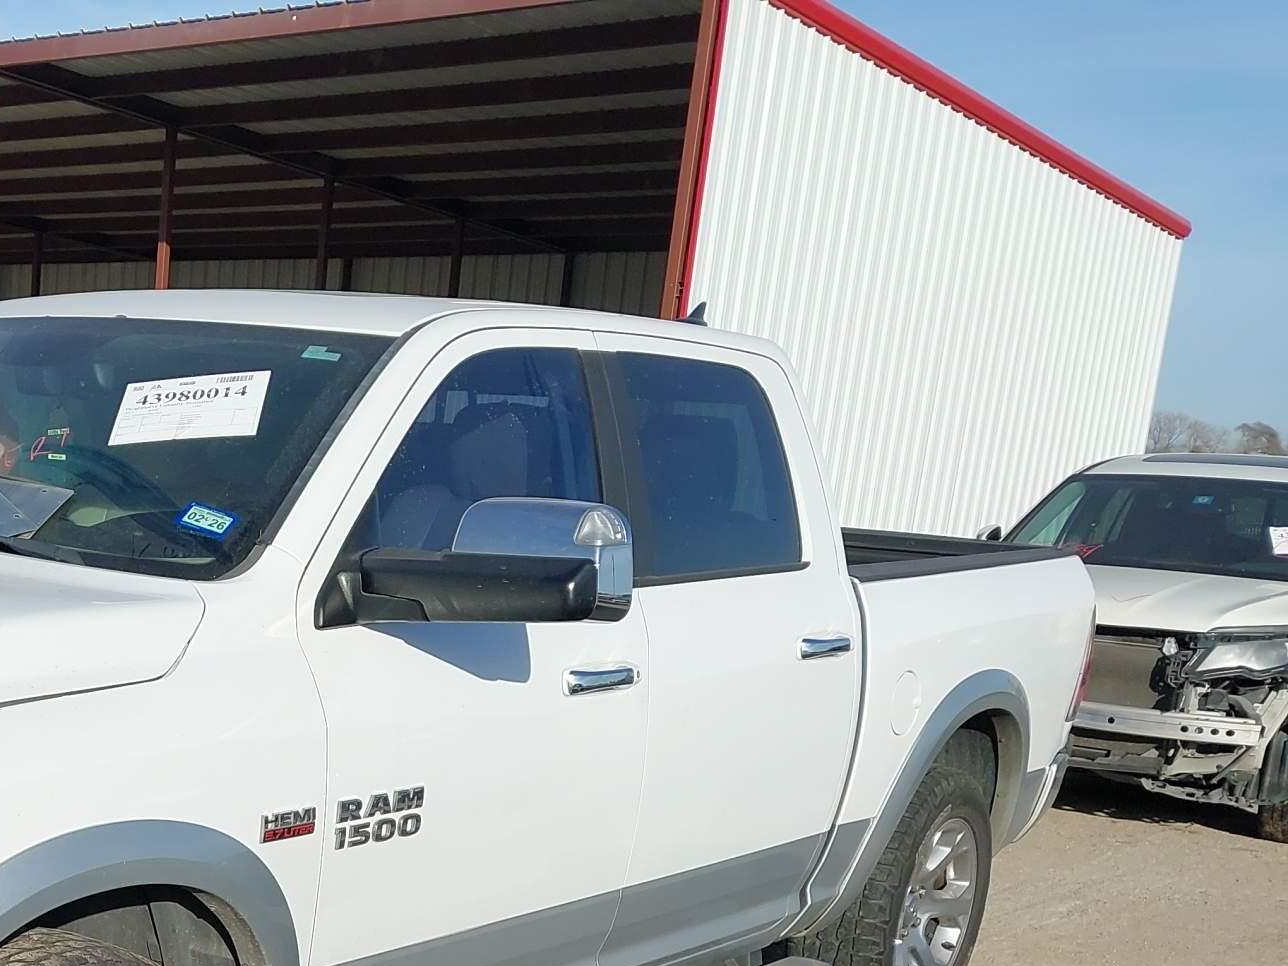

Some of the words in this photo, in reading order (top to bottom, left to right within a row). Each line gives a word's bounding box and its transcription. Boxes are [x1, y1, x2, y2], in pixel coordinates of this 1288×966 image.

[136, 385, 248, 406] 43980014
[187, 511, 205, 523] 02
[207, 518, 227, 530] 26
[336, 785, 425, 824] RAM
[261, 807, 317, 830] HEMI
[284, 824, 314, 838] LITER
[334, 813, 422, 851] 1500
